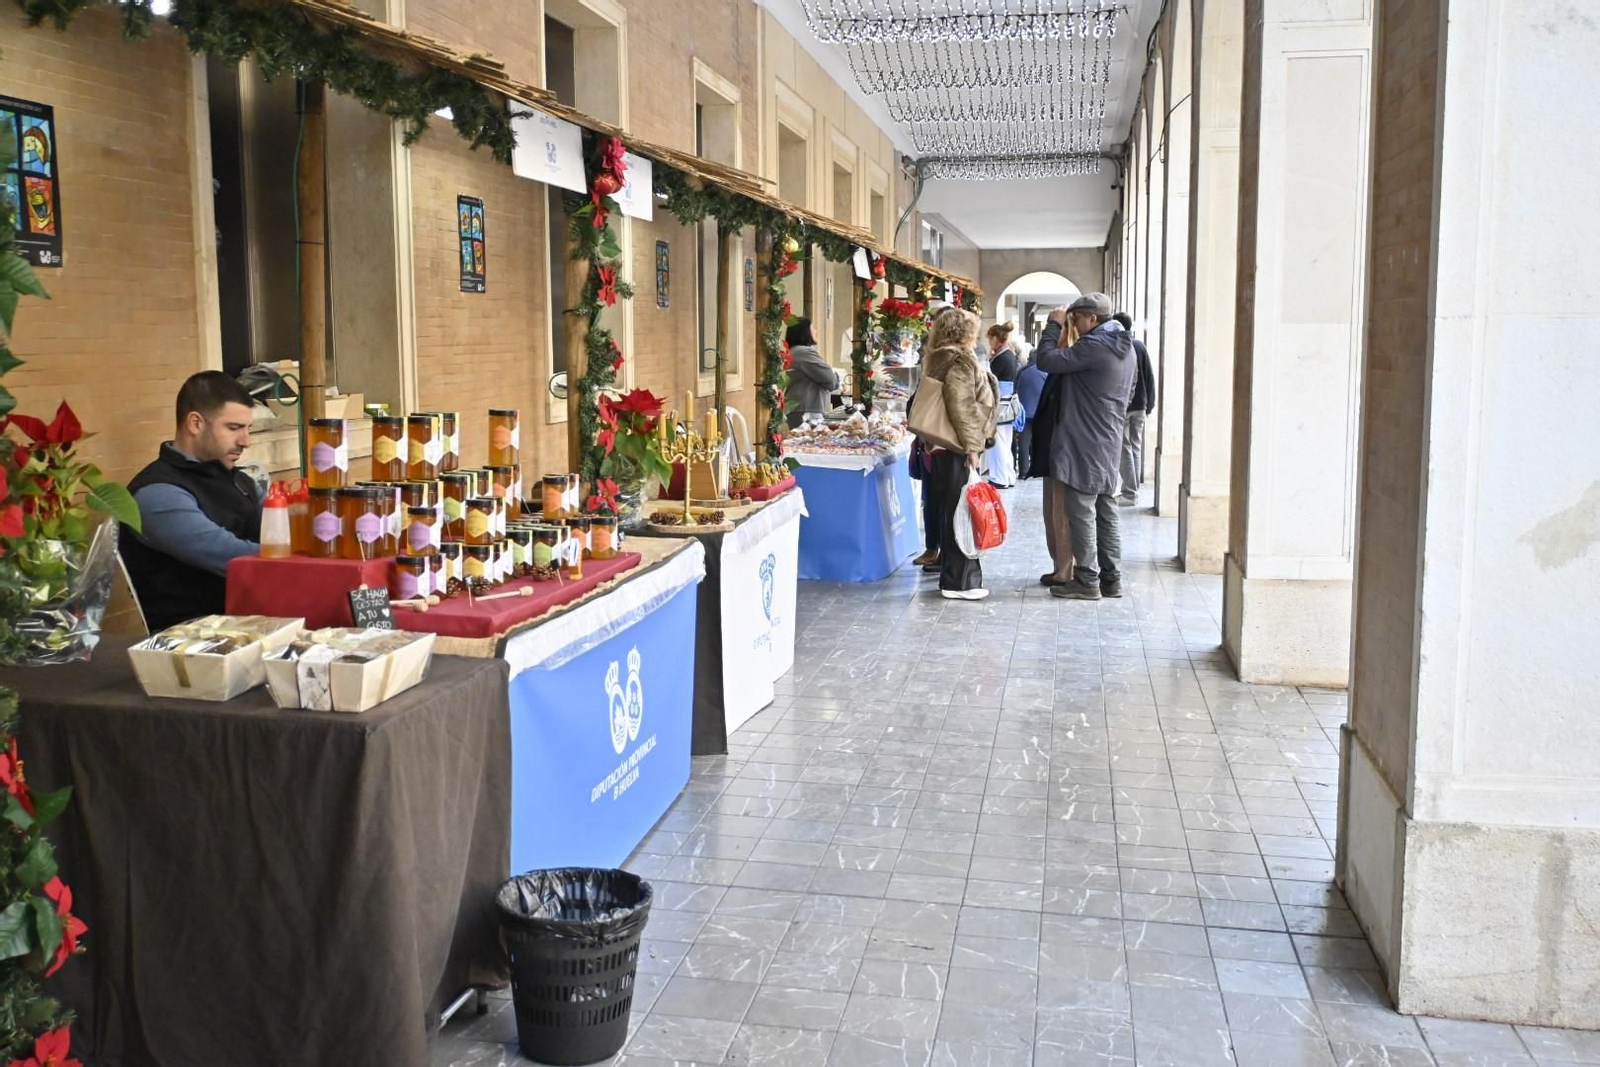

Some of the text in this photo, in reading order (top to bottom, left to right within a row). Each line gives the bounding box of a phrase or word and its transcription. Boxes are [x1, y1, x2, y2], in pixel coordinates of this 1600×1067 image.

[356, 598, 385, 609] CESTAS
[358, 610, 378, 622] A TU
[590, 759, 628, 803] DIPUTACIÓN
[619, 766, 640, 796] HUELVA
